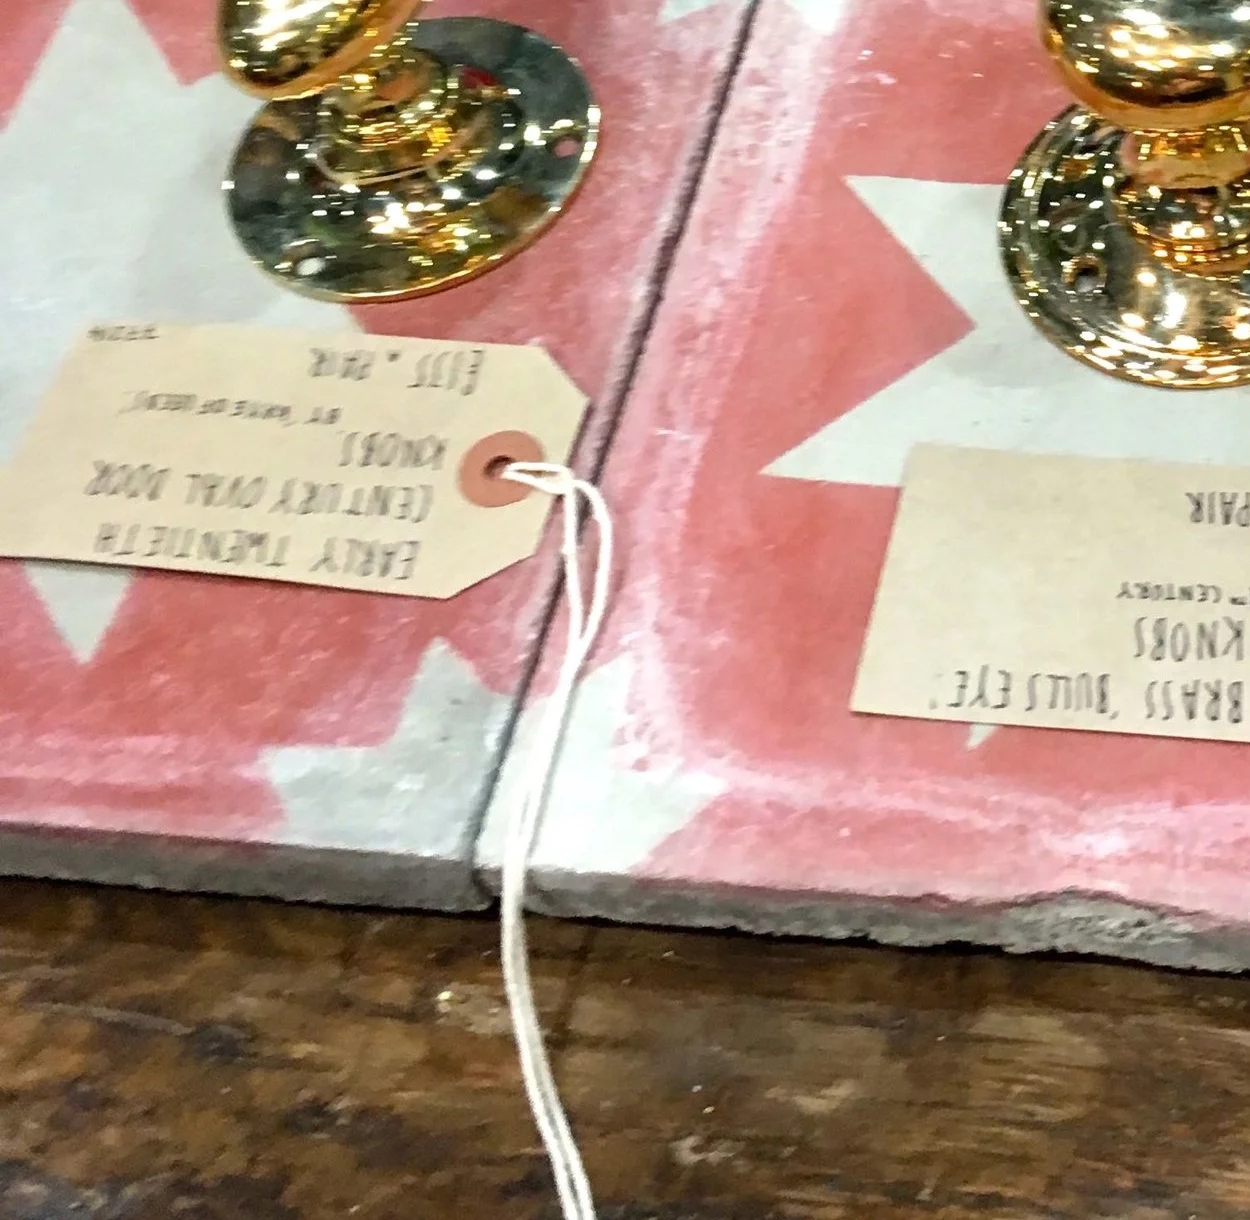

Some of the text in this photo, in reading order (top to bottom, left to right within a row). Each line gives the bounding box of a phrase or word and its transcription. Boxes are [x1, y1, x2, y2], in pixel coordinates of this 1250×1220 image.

[308, 348, 376, 382] PAIR
[84, 460, 434, 524] CENTURY OVAL DOOR
[93, 523, 421, 581] EARLY TWENTIETH
[1114, 582, 1222, 604] CENTURY
[1133, 616, 1245, 663] KNOBS
[1144, 680, 1244, 724] BRASS
